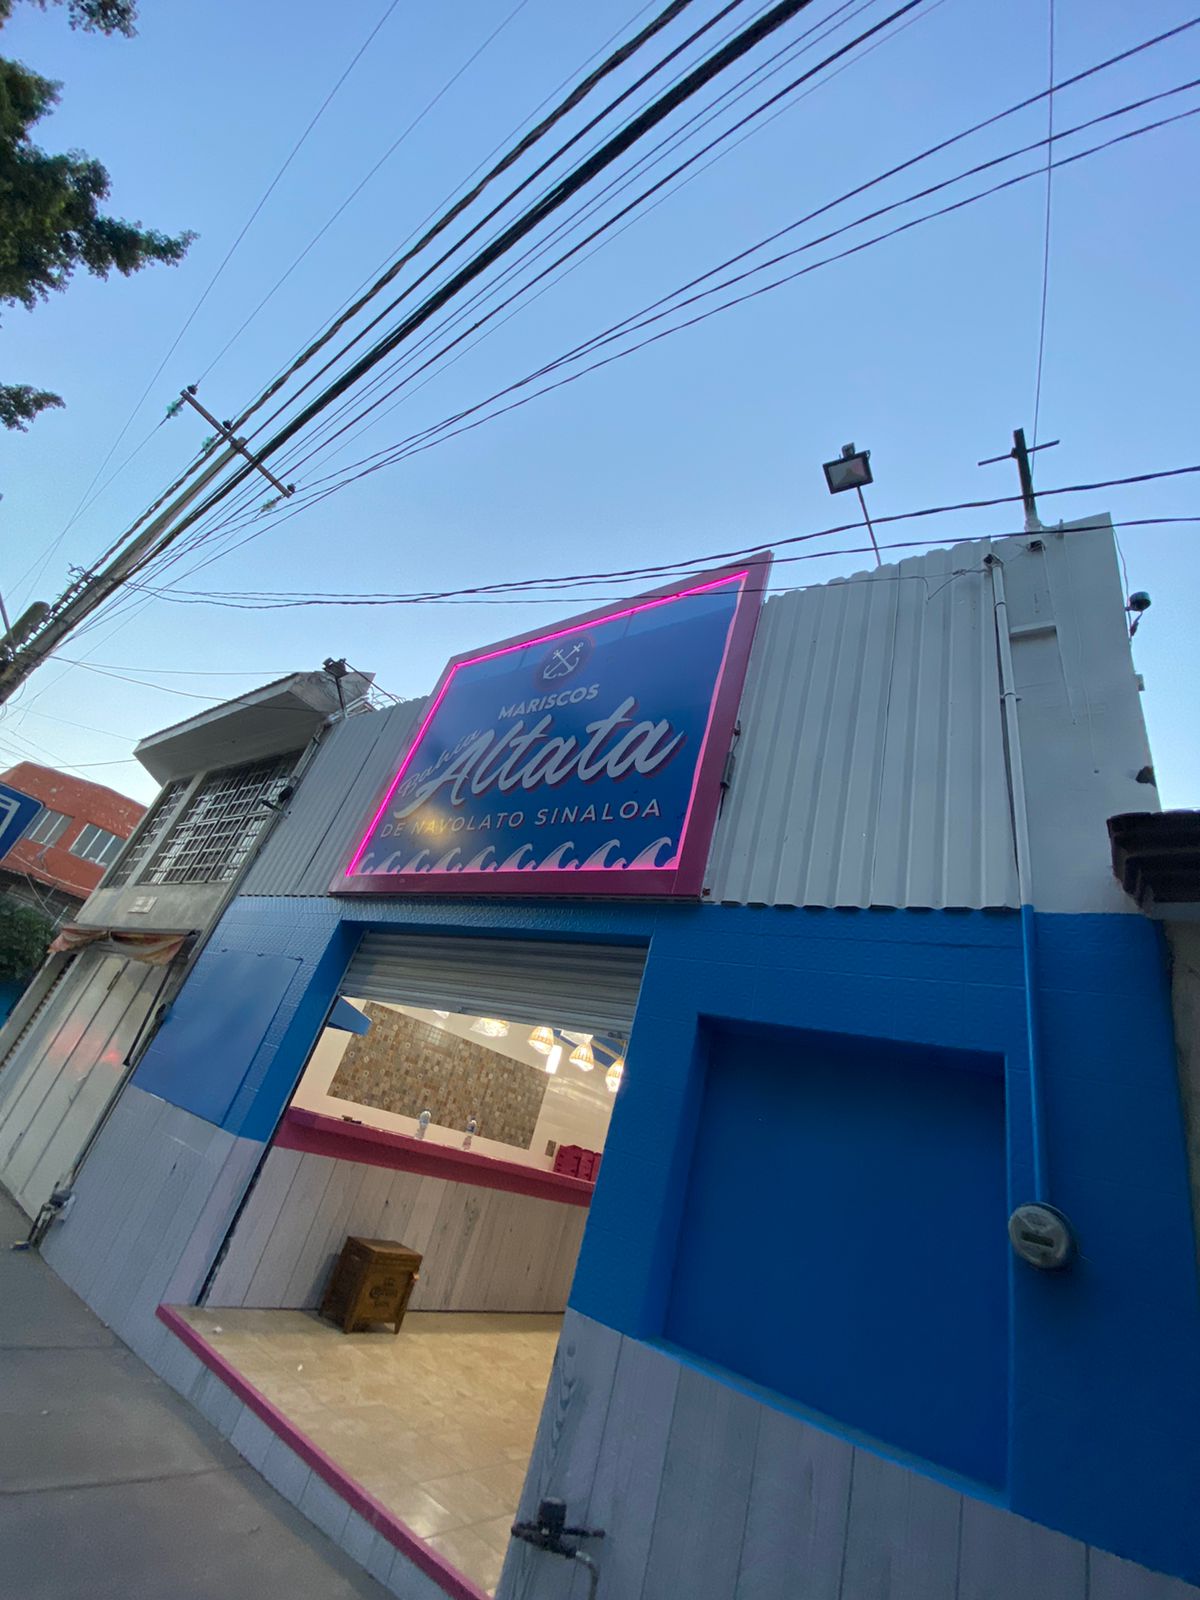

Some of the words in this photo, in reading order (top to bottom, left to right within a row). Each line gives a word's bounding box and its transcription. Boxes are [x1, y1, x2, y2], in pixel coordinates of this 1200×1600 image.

[498, 684, 600, 720] MARISCOS
[393, 696, 685, 819] Altata
[380, 822, 406, 838] DE
[410, 811, 524, 835] NAVOLATO
[534, 798, 661, 826] SINALOA
